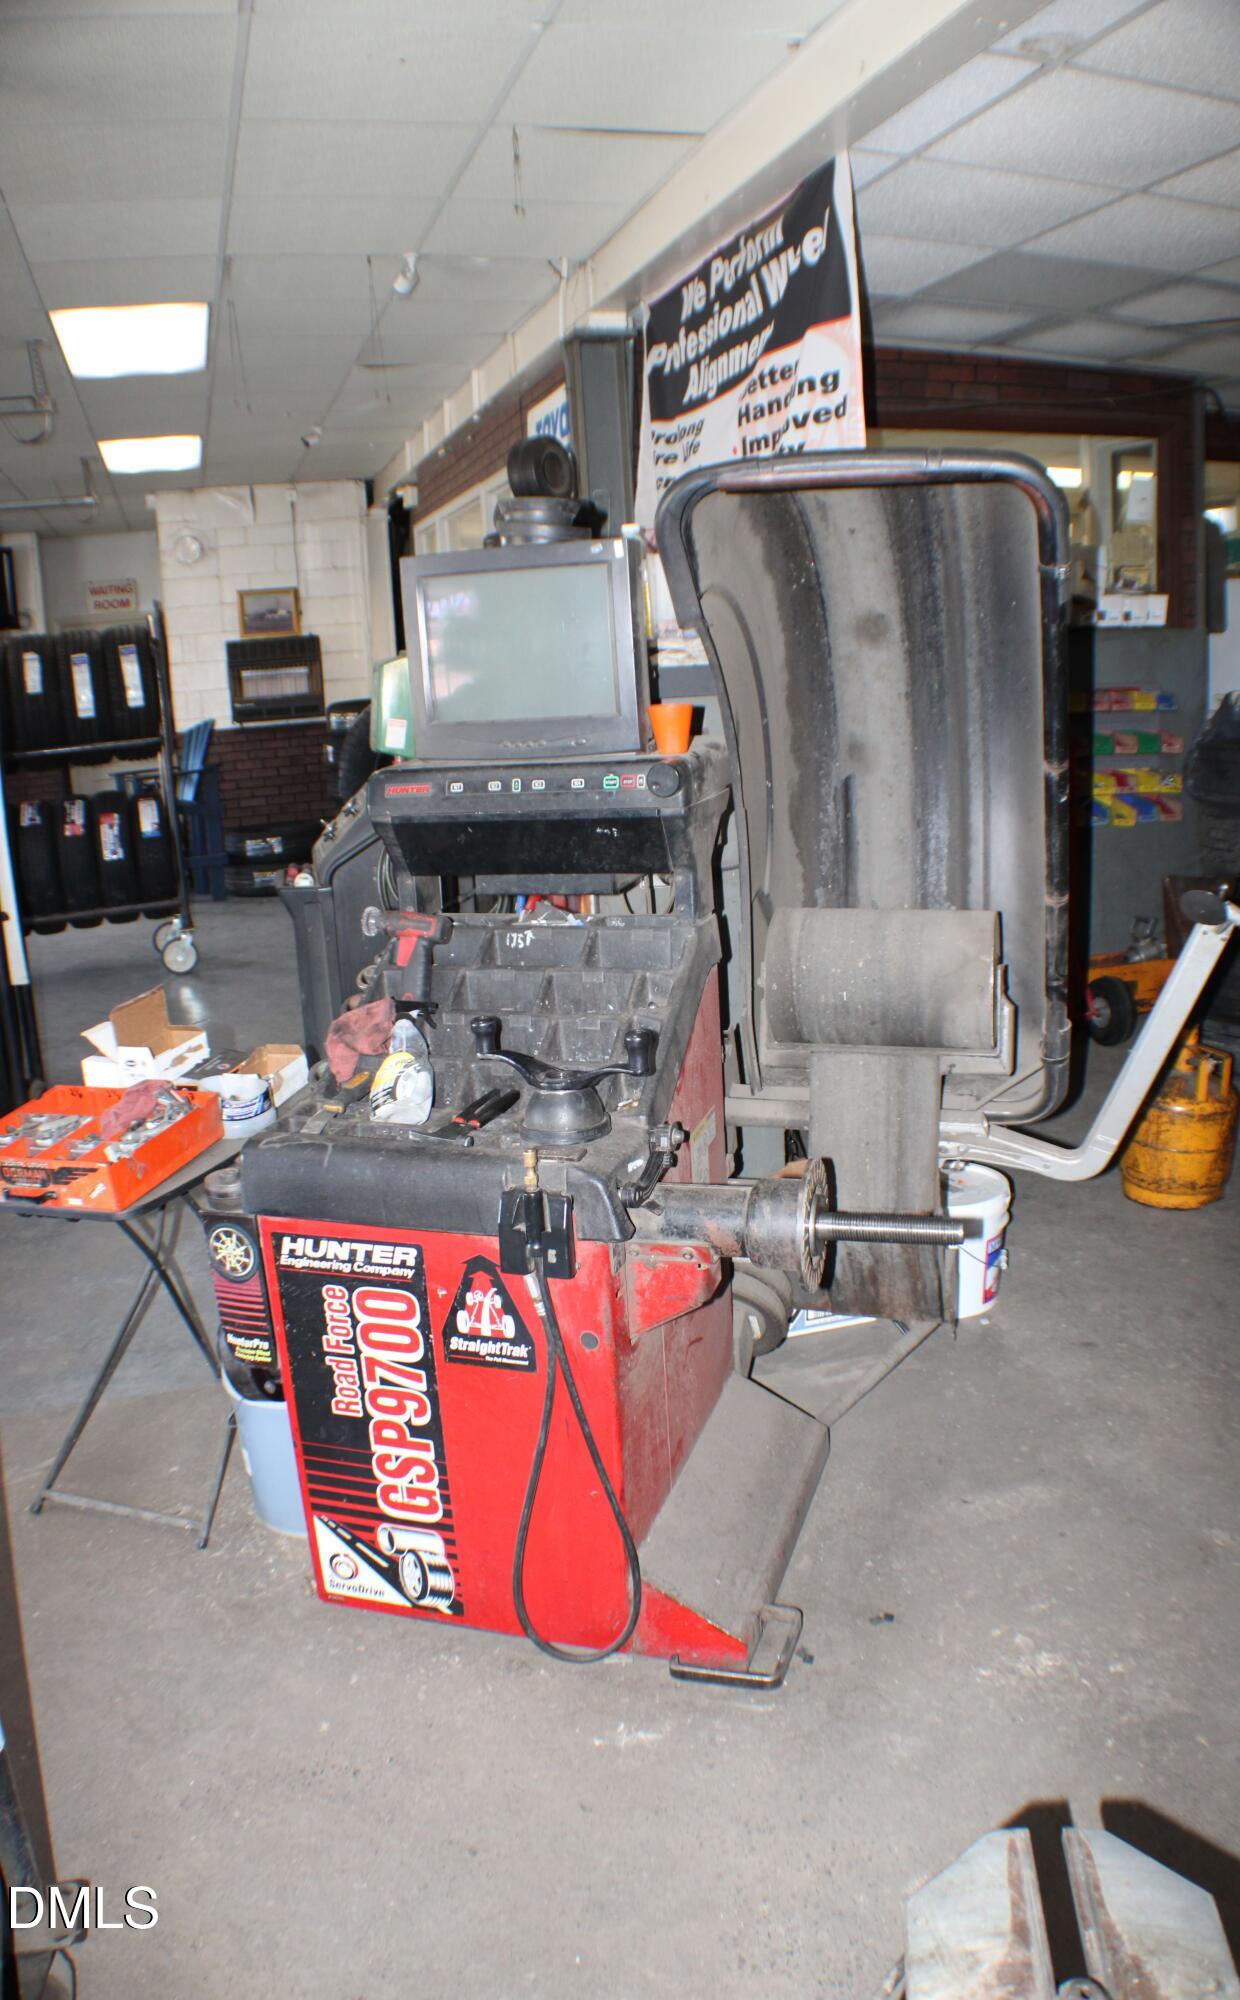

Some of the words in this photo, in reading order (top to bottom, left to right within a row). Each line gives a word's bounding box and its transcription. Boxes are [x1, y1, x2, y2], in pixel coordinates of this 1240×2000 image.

[680, 275, 707, 325] We
[682, 320, 775, 406] Alignme
[651, 417, 705, 446] rolong
[741, 393, 849, 458] Impved
[88, 584, 133, 596] WAITING
[93, 598, 131, 609] ROOM
[387, 784, 430, 794] HUNTER
[280, 1254, 351, 1273] Engineering
[353, 1261, 415, 1279] Company
[281, 1236, 418, 1267] HUNTER
[321, 1284, 355, 1355] Force
[449, 1335, 529, 1358] StraightTrak
[331, 1355, 363, 1417] Road
[352, 1286, 443, 1523] GSP9700
[329, 1578, 385, 1597] ServoDrive
